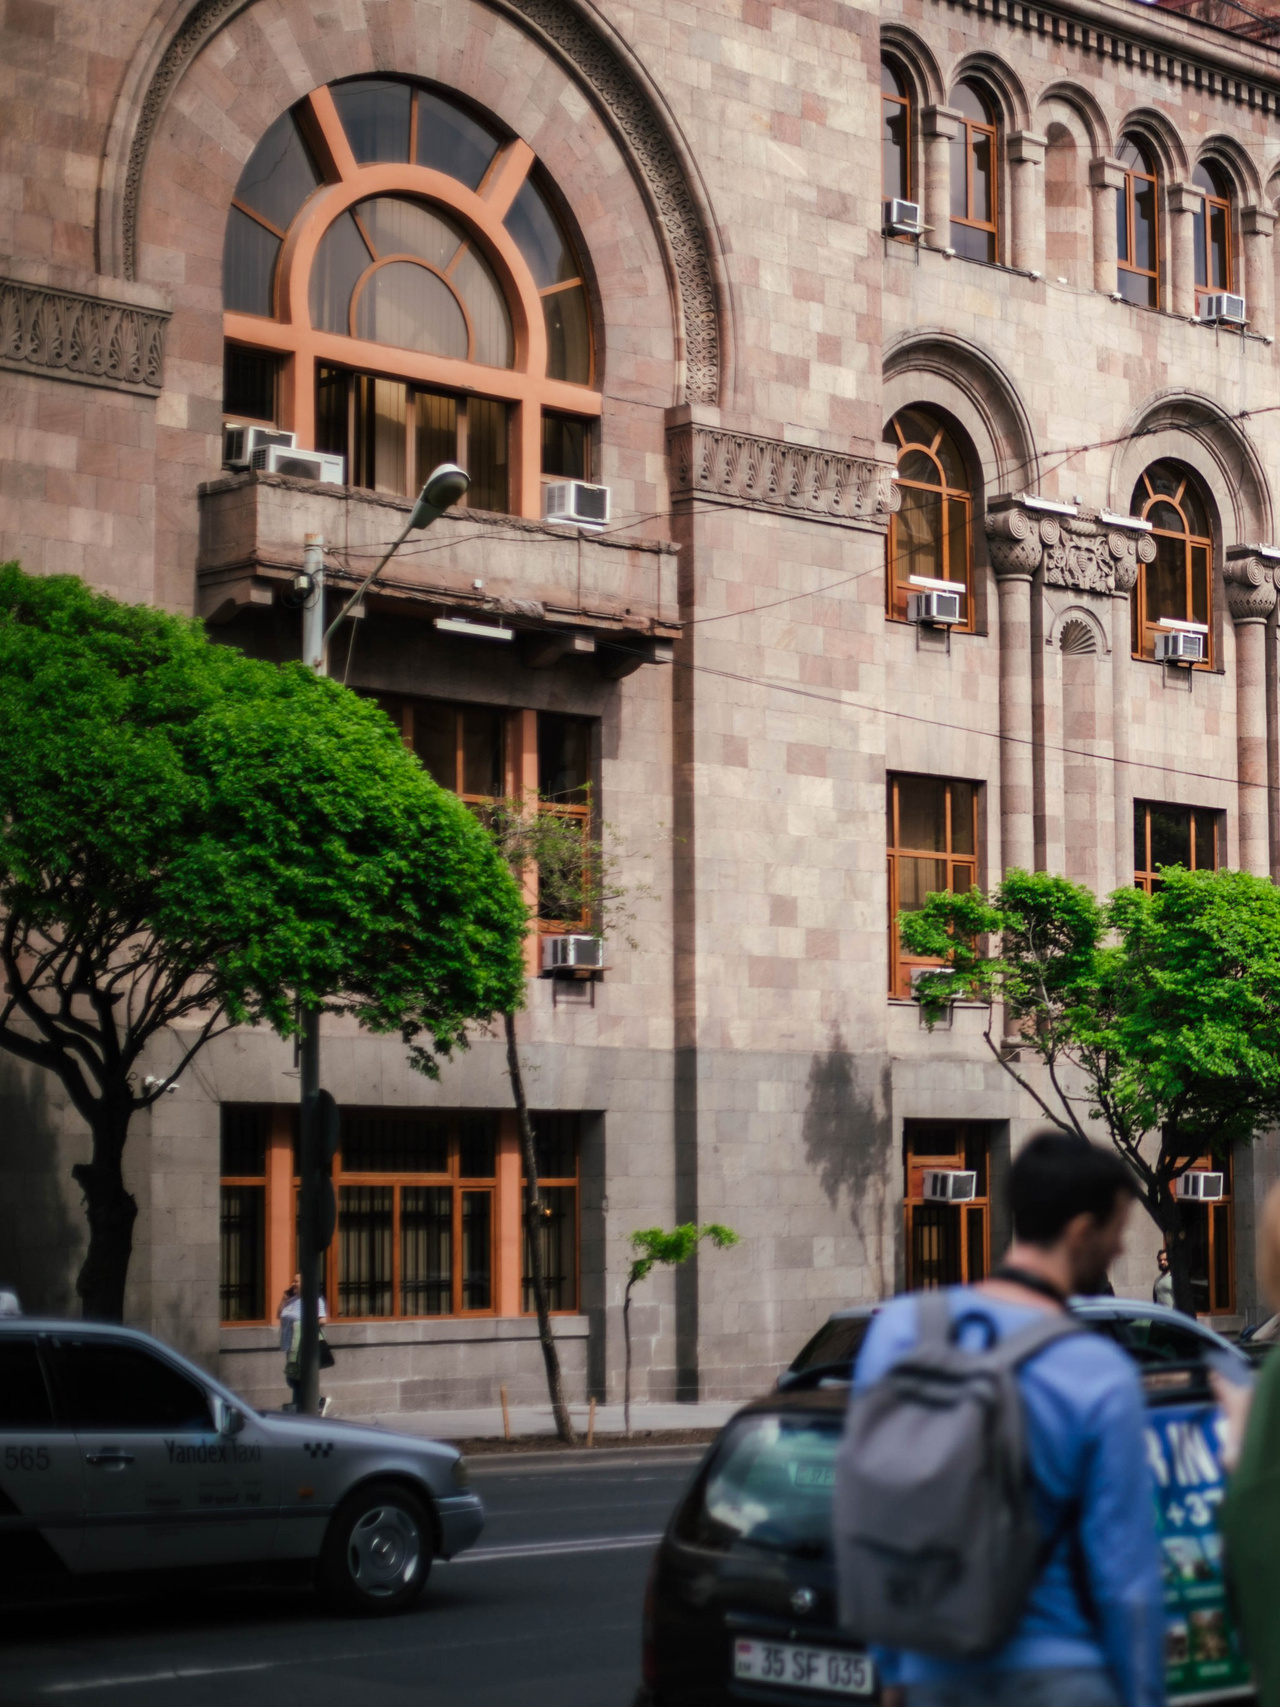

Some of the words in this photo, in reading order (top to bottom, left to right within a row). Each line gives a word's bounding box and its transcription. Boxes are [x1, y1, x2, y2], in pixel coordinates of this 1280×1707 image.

[5, 1446, 50, 1471] 565
[164, 1439, 227, 1464] Yandex
[228, 1438, 261, 1463] Taxi
[761, 1647, 785, 1678] 35
[792, 1650, 820, 1681] SF
[828, 1655, 866, 1687] 035
